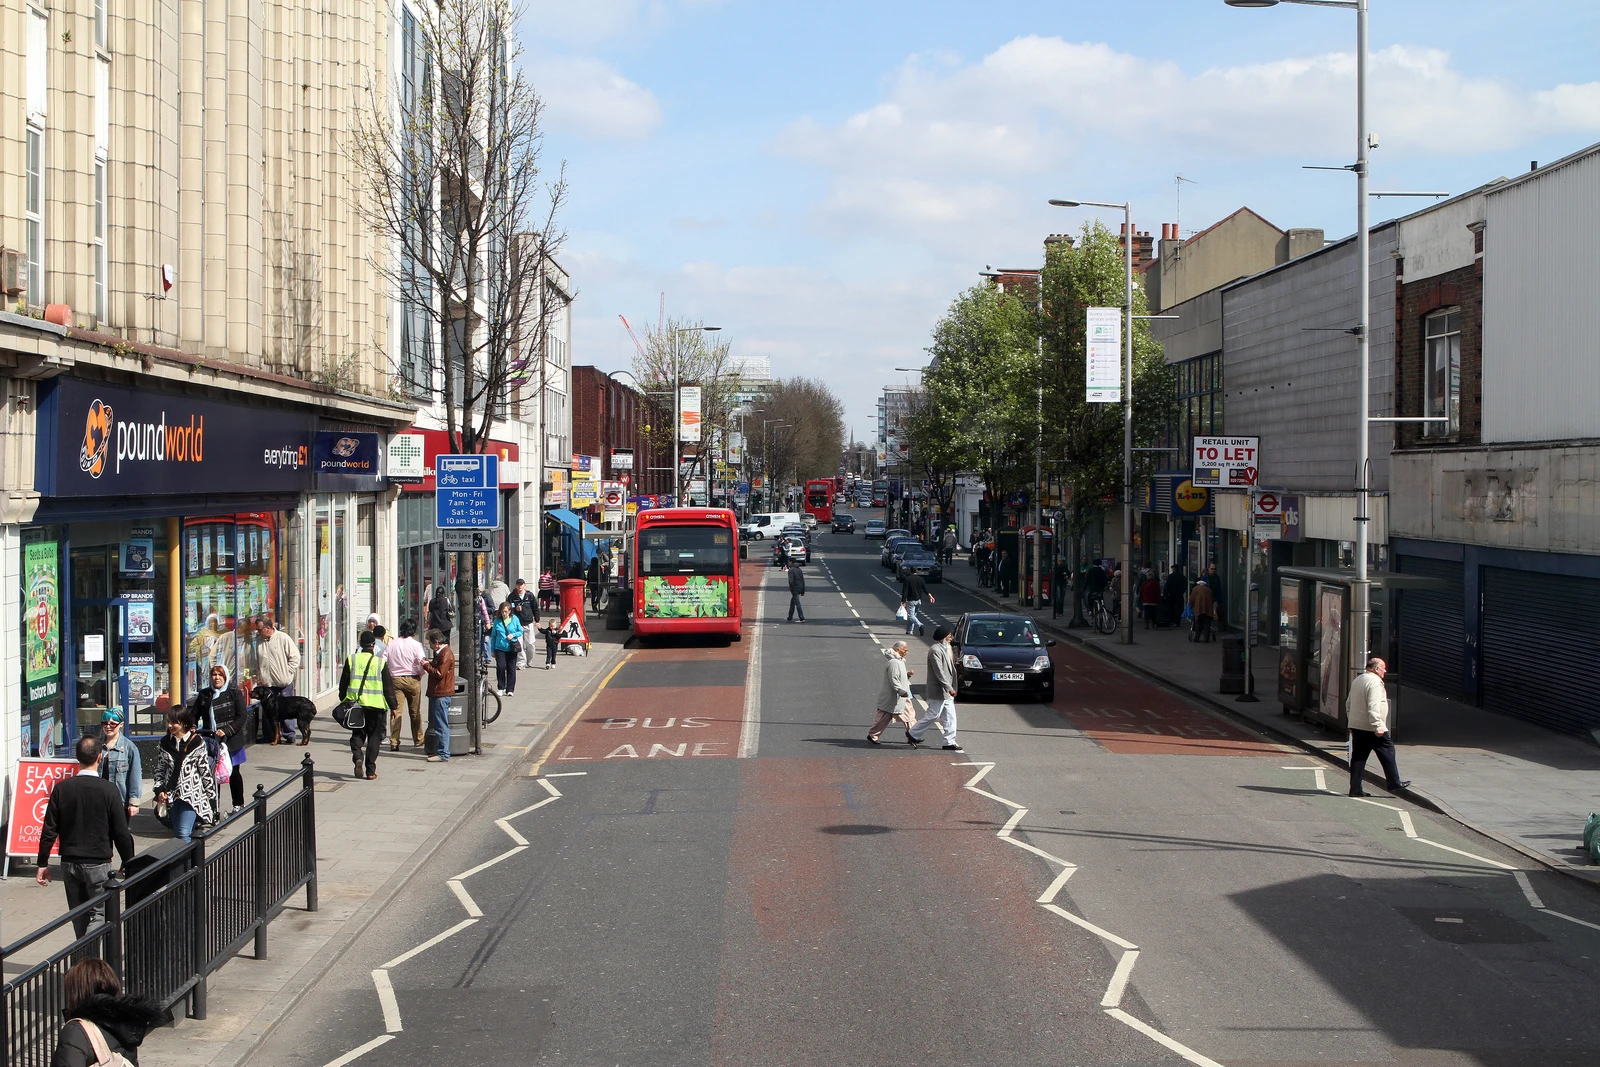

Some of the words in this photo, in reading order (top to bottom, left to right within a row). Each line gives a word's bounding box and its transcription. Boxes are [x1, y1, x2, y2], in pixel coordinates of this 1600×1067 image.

[117, 411, 204, 475] poundworld
[1202, 438, 1229, 446] RETAIL
[264, 445, 298, 470] everything
[1196, 447, 1219, 460] TO
[1224, 448, 1256, 461] LET
[321, 459, 370, 469] poundworld
[1246, 469, 1255, 480] V
[39, 616, 47, 634] £1
[30, 684, 47, 701] Instore
[47, 681, 57, 698] Now
[602, 716, 715, 730] BUS
[557, 742, 729, 760] LANE
[26, 766, 74, 779] FLASH
